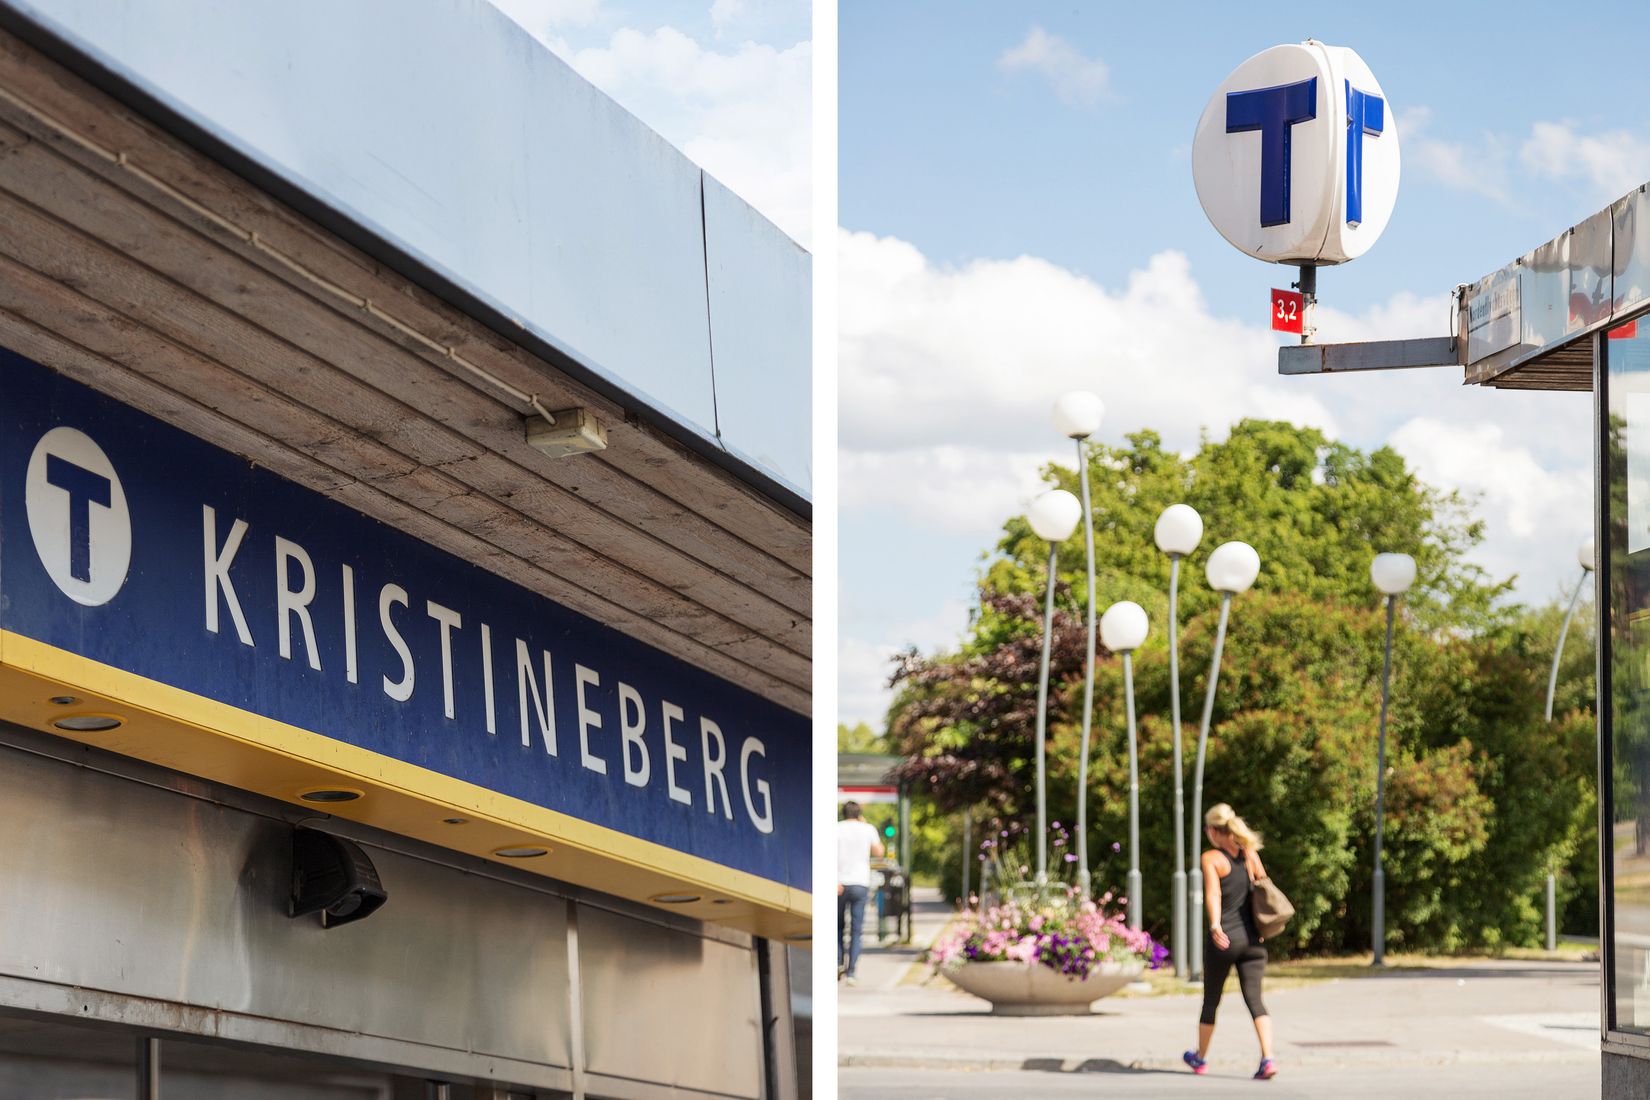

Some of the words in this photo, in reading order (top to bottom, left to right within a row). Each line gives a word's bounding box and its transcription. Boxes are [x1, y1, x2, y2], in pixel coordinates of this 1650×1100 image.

[1226, 76, 1318, 226] T
[1277, 299, 1297, 323] 3,2
[46, 453, 111, 583] T
[202, 503, 774, 834] KRISTINEBERG
